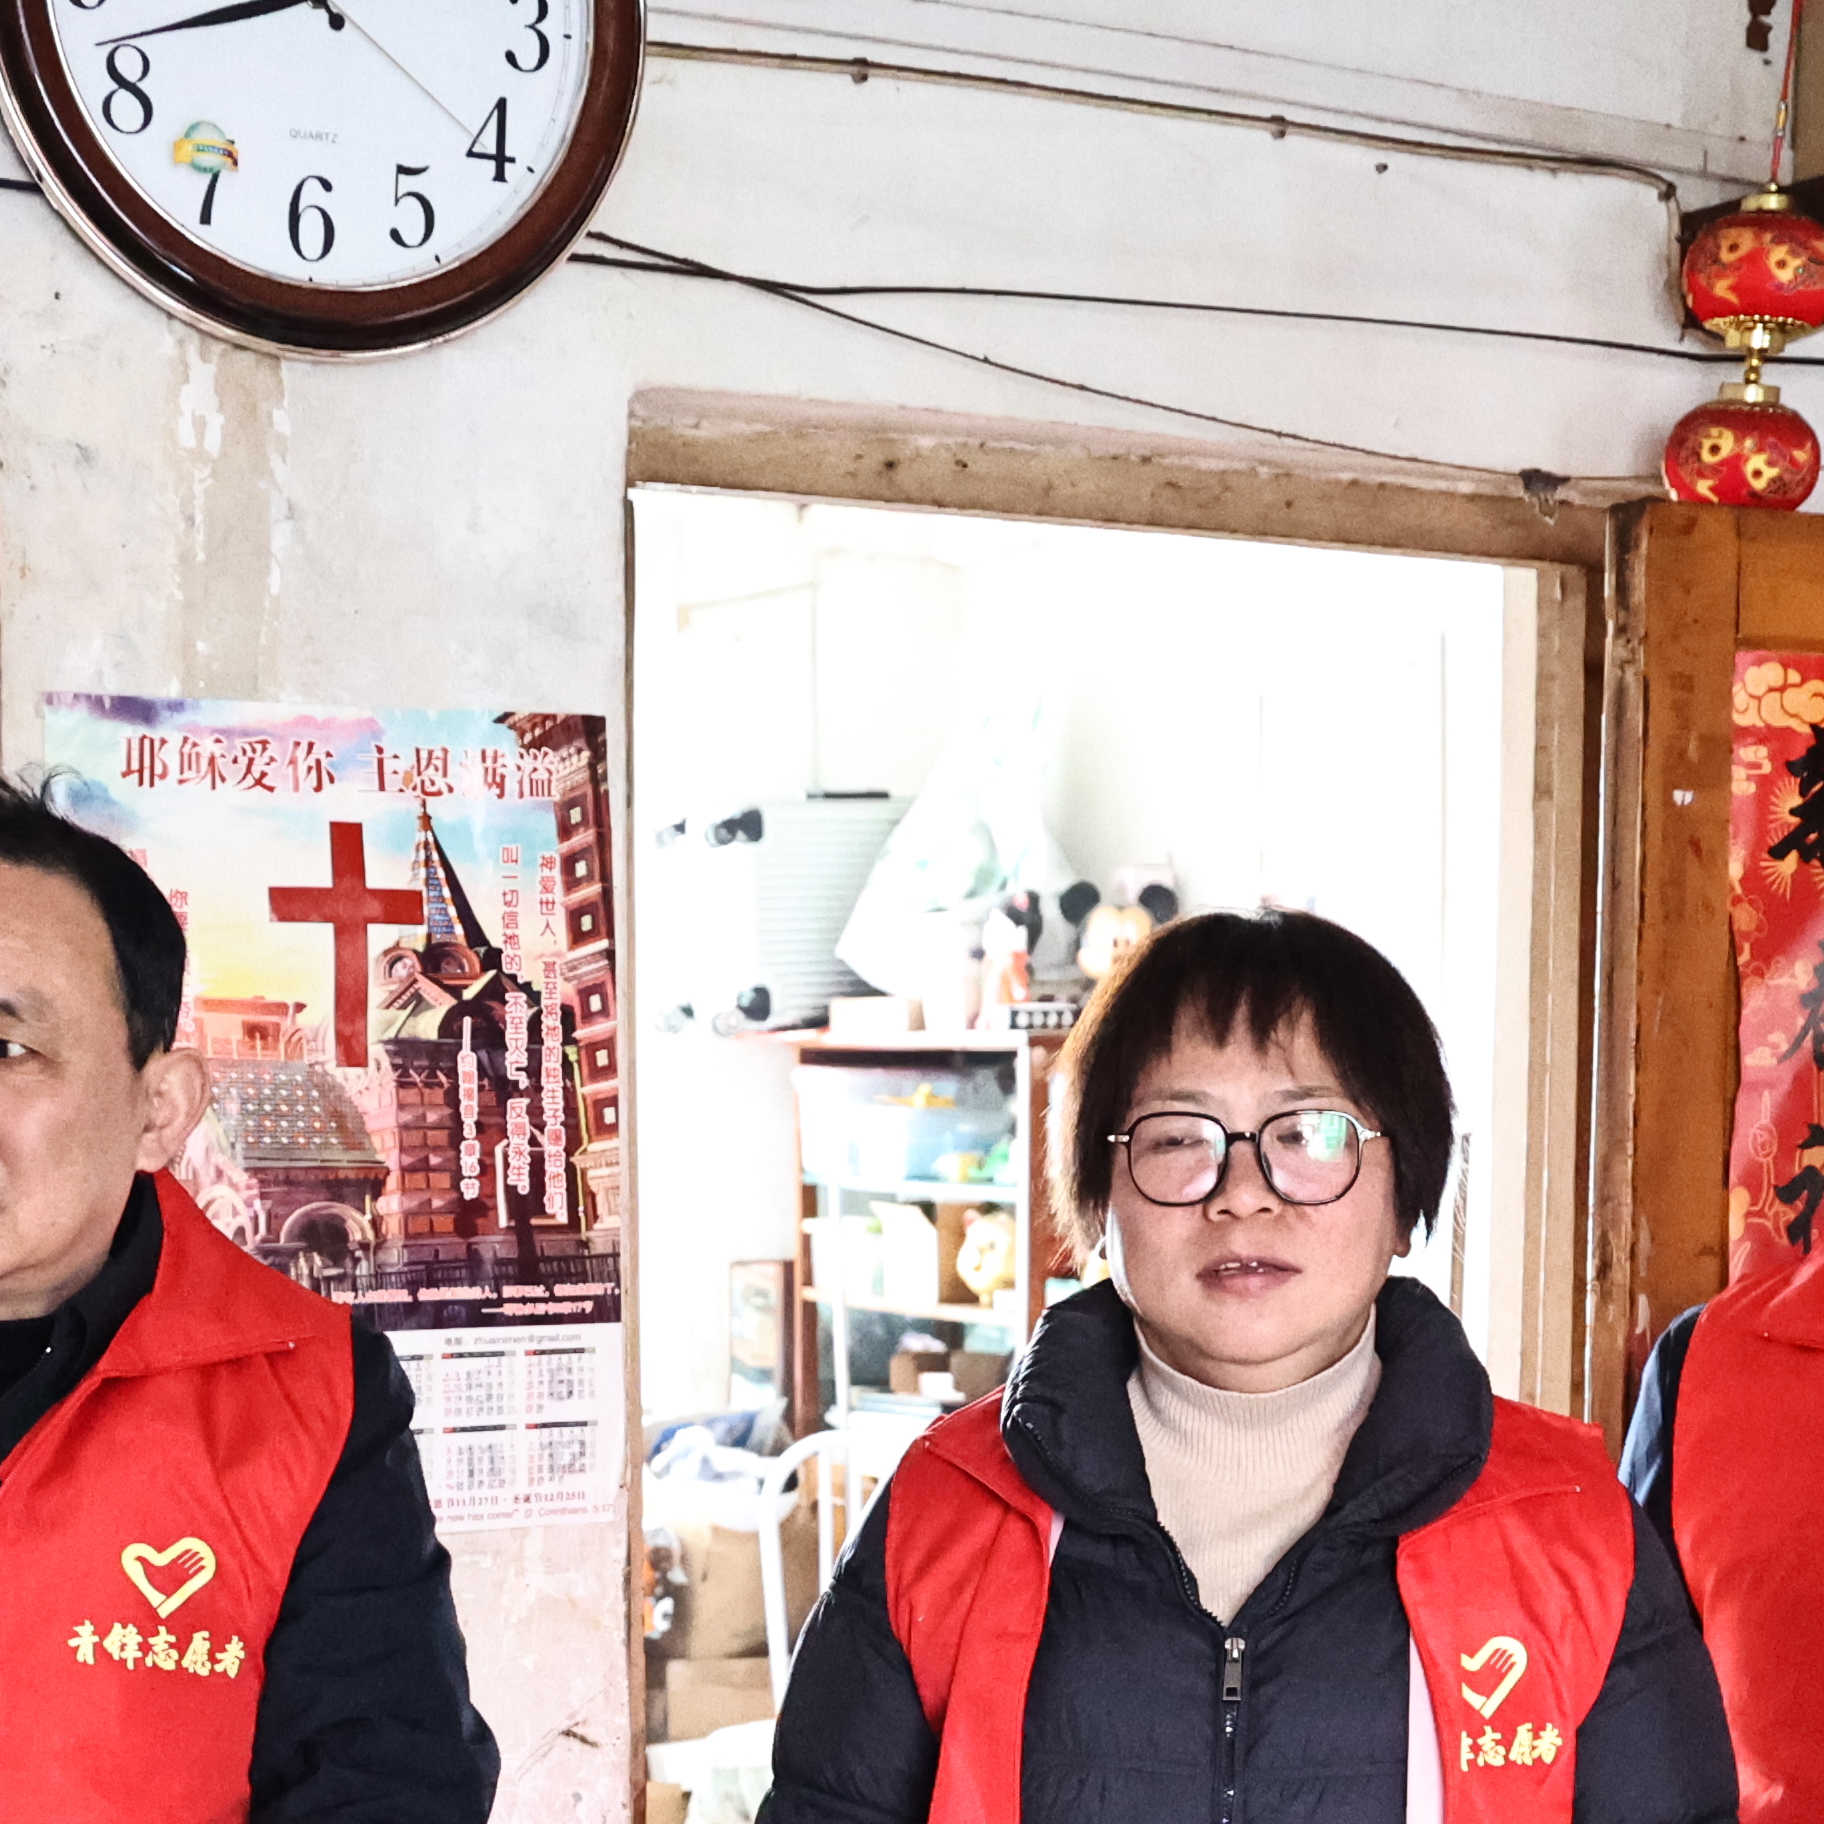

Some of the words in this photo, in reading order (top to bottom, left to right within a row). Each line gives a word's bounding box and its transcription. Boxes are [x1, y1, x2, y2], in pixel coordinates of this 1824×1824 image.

[101, 43, 154, 134] 8
[289, 127, 339, 143] QUARTZ
[464, 96, 516, 183] 4
[287, 175, 336, 262] 6
[389, 163, 435, 249] 5
[119, 733, 335, 793] 耶稣爱你
[357, 744, 558, 800] 主恩满溢
[67, 1619, 246, 1679] 青锋志愿者
